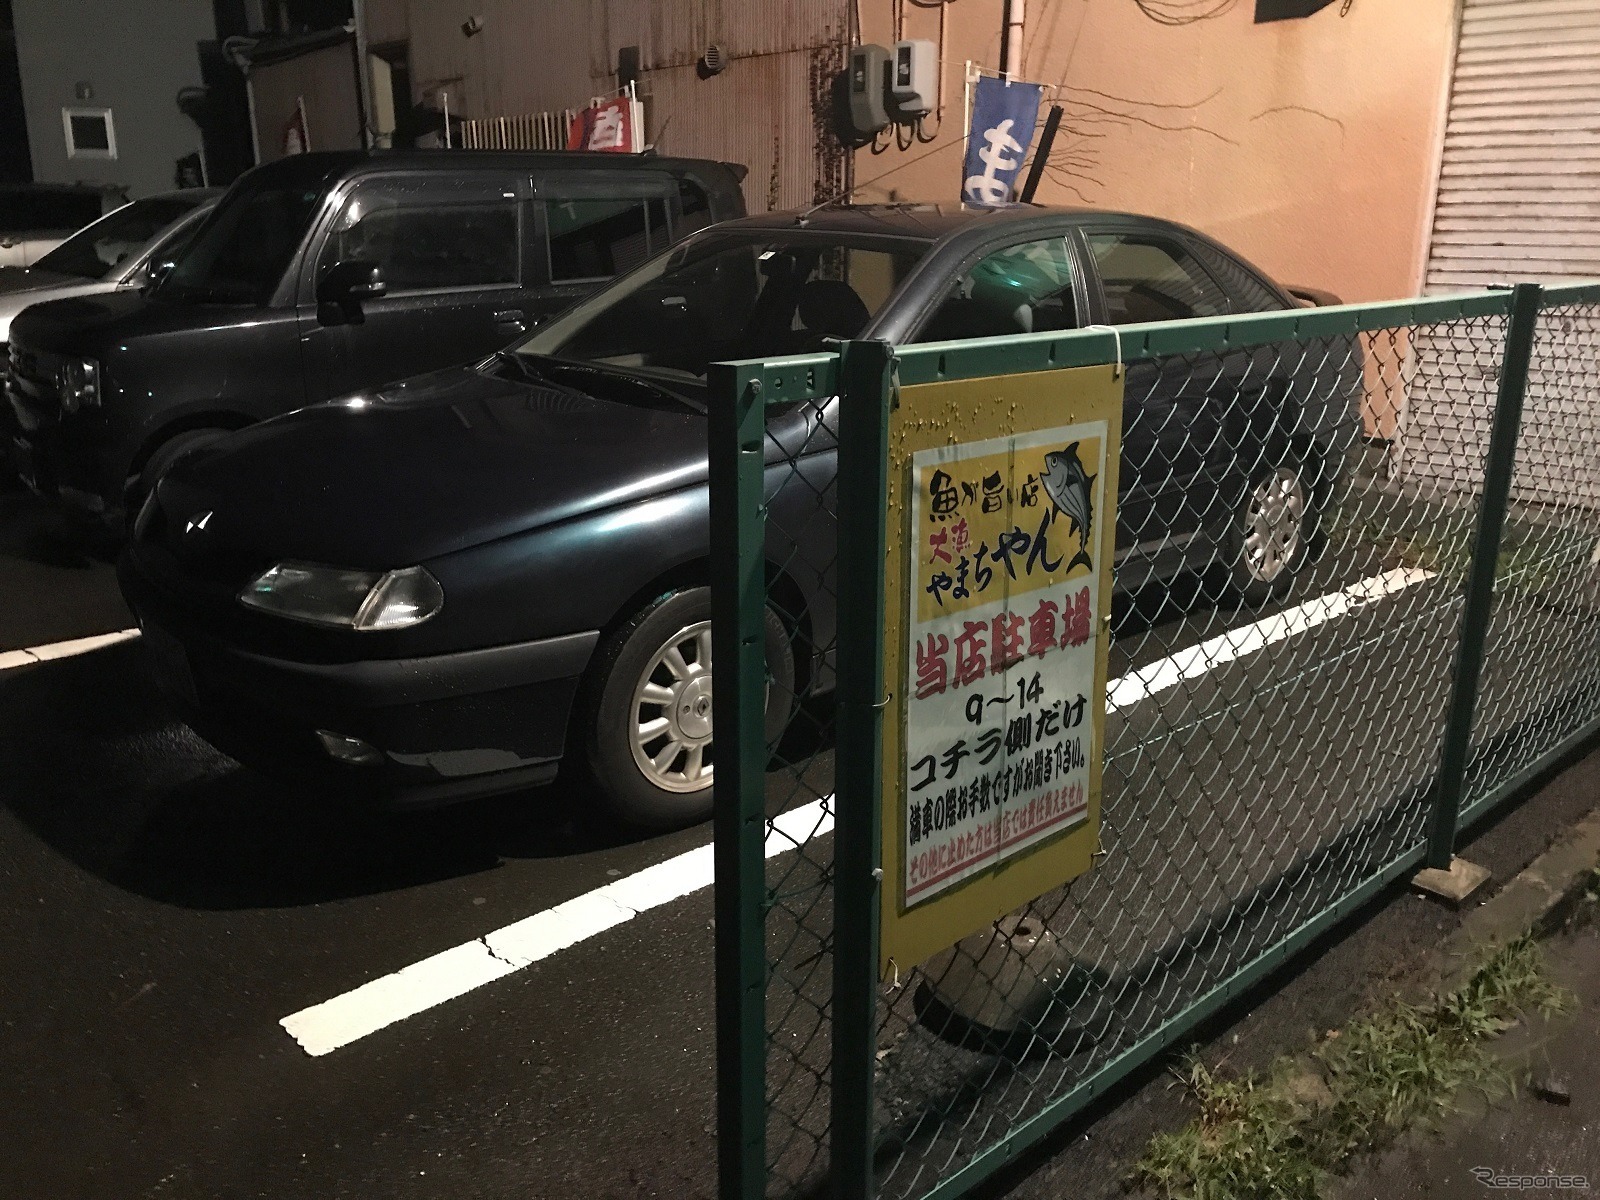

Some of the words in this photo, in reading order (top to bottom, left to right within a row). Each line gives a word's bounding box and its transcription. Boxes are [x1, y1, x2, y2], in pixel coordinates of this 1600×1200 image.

[929, 517, 971, 564] 大漁
[915, 585, 1091, 700] 当店駐車場
[910, 694, 1087, 792] コチラ側だけ
